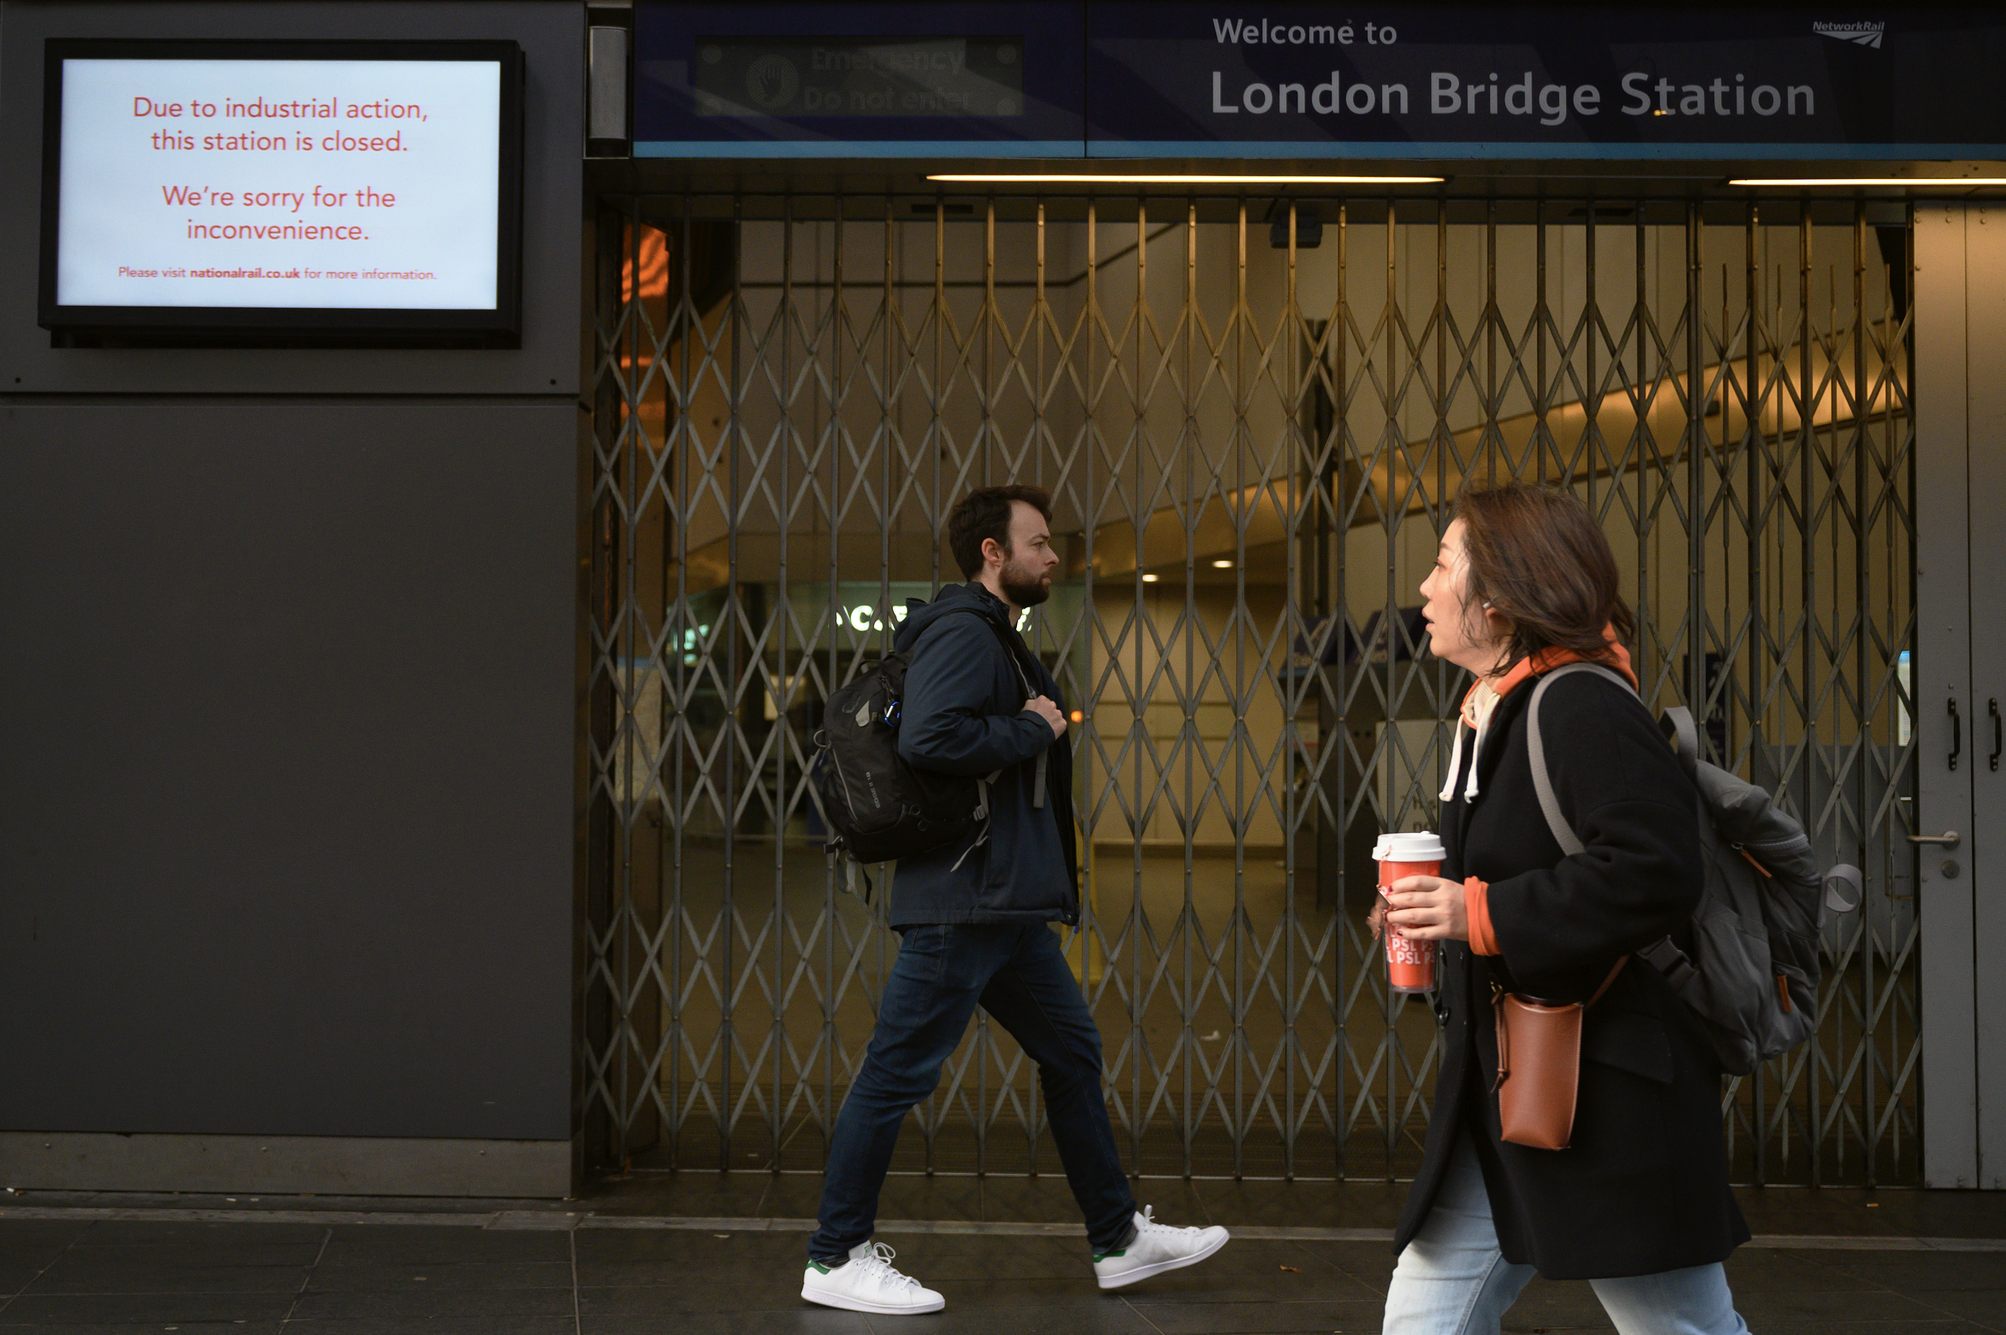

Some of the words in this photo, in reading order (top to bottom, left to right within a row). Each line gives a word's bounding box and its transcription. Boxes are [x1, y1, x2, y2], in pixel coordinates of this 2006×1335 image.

[1212, 18, 1354, 45] Welcome
[1364, 22, 1398, 45] to
[132, 96, 184, 119] Due
[191, 98, 218, 119] to
[225, 96, 338, 119] industrial
[345, 97, 429, 123] action,
[803, 86, 842, 111] Do
[849, 86, 895, 111] not
[1212, 70, 1409, 115] London
[1430, 71, 1601, 126] Bridge
[1620, 72, 1815, 116] Station
[150, 128, 196, 151] this
[202, 129, 287, 152] station
[295, 130, 314, 152] is
[321, 129, 409, 152] closed.
[242, 191, 305, 214] sorry
[311, 184, 349, 207] for
[354, 185, 397, 208] the
[187, 218, 370, 241] inconvenience.
[118, 265, 159, 279] Please
[161, 266, 187, 279] visit
[190, 266, 301, 280] nationalrail.co.uk
[303, 267, 323, 280] for
[325, 270, 359, 281] more
[362, 267, 438, 281] information.
[1391, 937, 1417, 952] PSL
[1396, 951, 1421, 965] PSL
